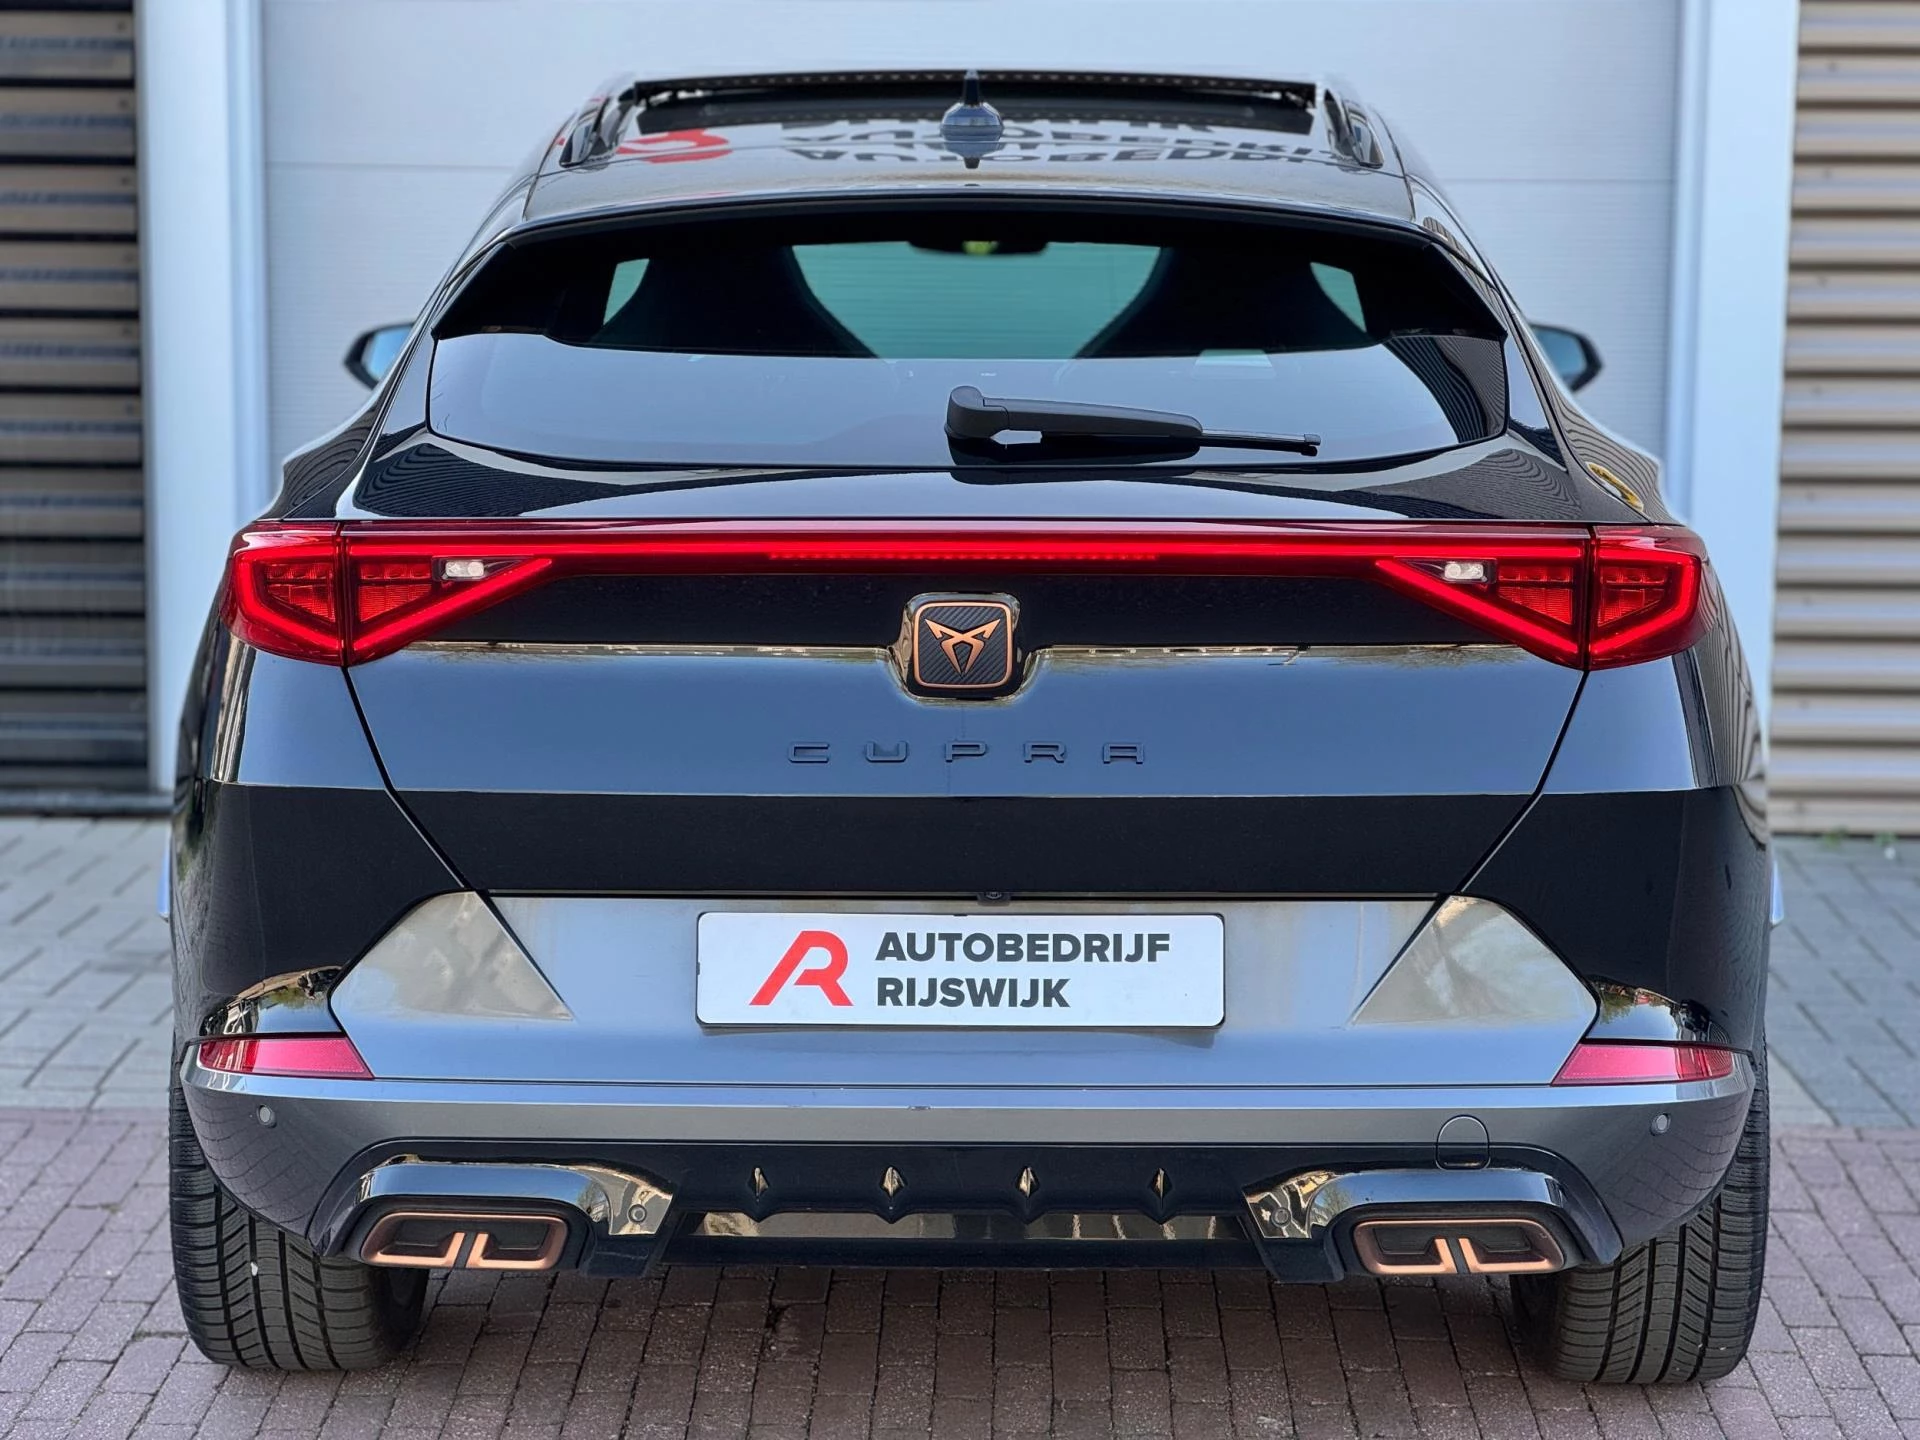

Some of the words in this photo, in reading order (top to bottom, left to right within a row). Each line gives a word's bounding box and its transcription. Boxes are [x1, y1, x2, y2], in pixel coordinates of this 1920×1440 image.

[787, 740, 1145, 765] CUPRA
[875, 931, 1171, 964] AUTOBEDRIJF
[876, 977, 1071, 1009] RIJSWIJK
